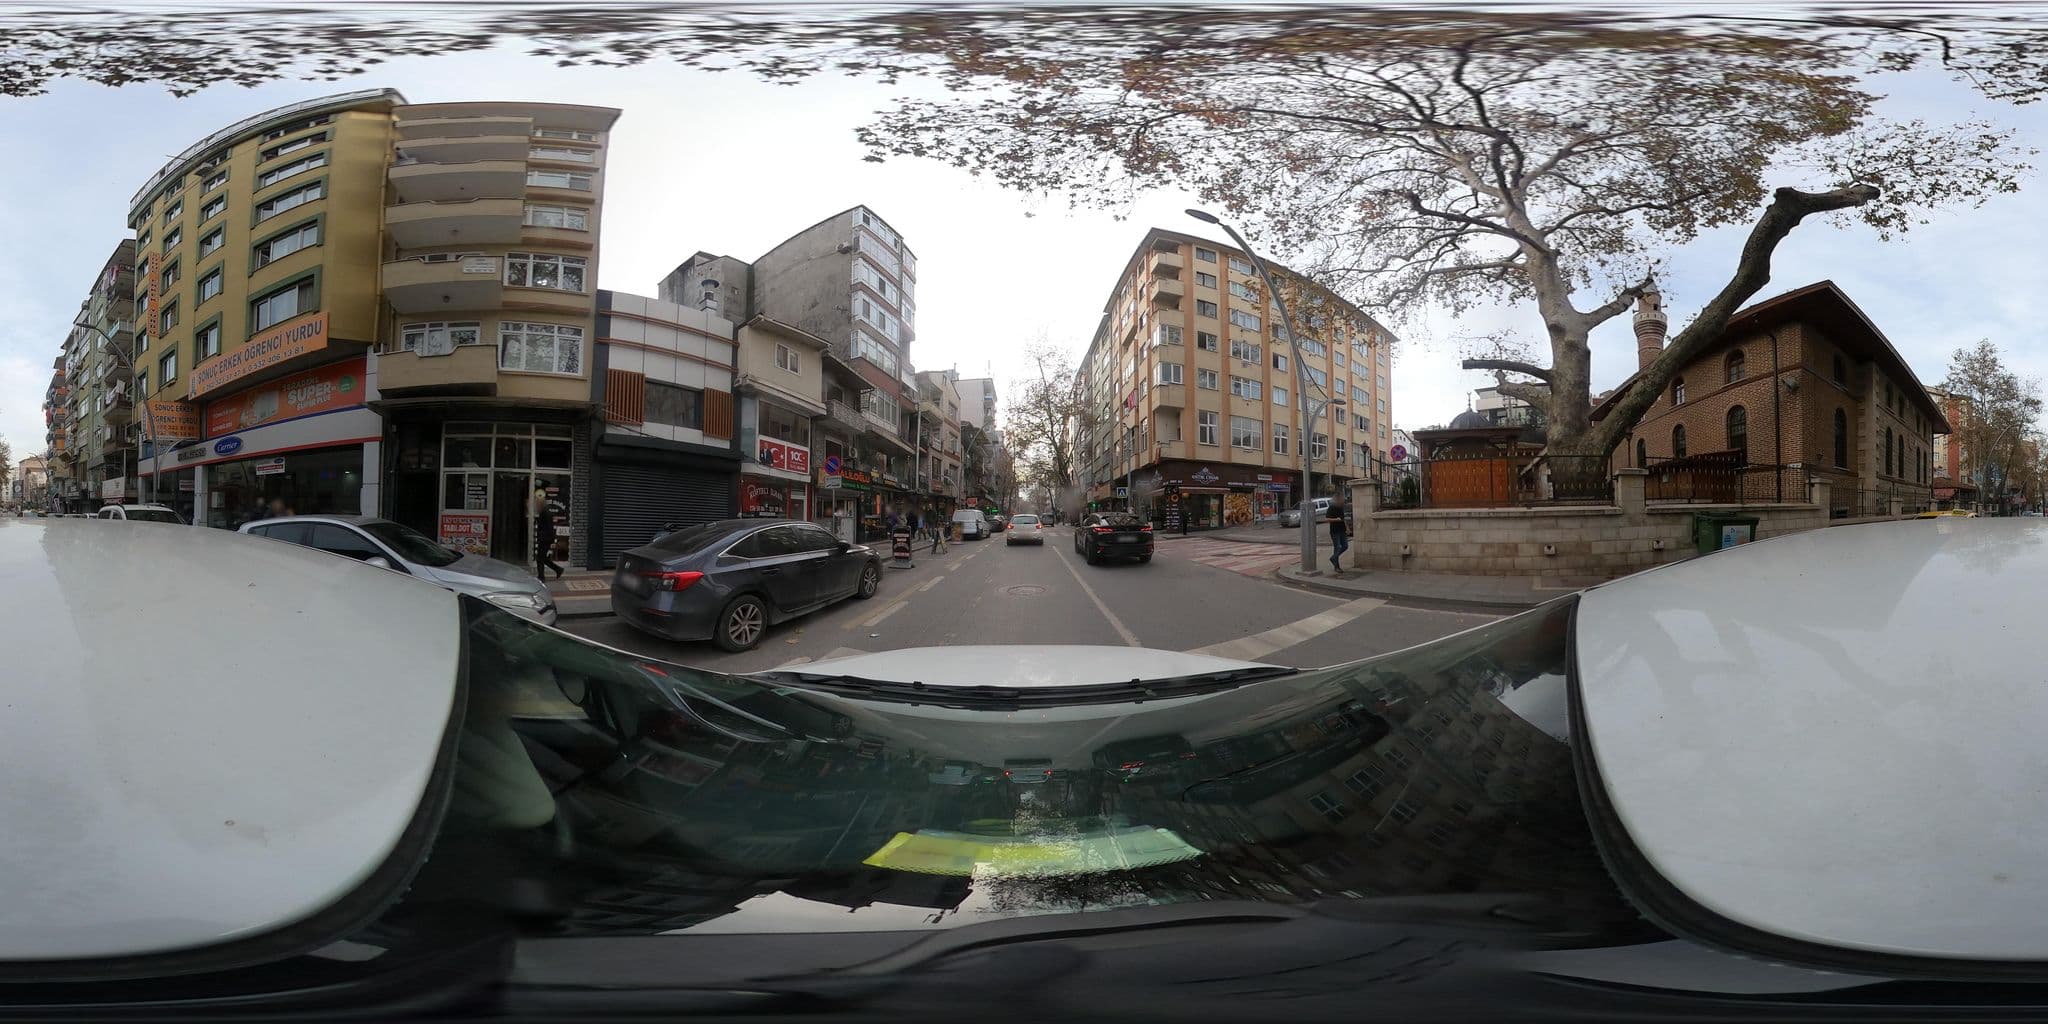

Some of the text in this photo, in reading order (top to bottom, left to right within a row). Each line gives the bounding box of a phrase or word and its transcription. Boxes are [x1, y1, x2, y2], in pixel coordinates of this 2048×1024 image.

[219, 351, 242, 372] ERKEK
[285, 319, 322, 345] YURDU
[287, 381, 332, 405] SUPER
